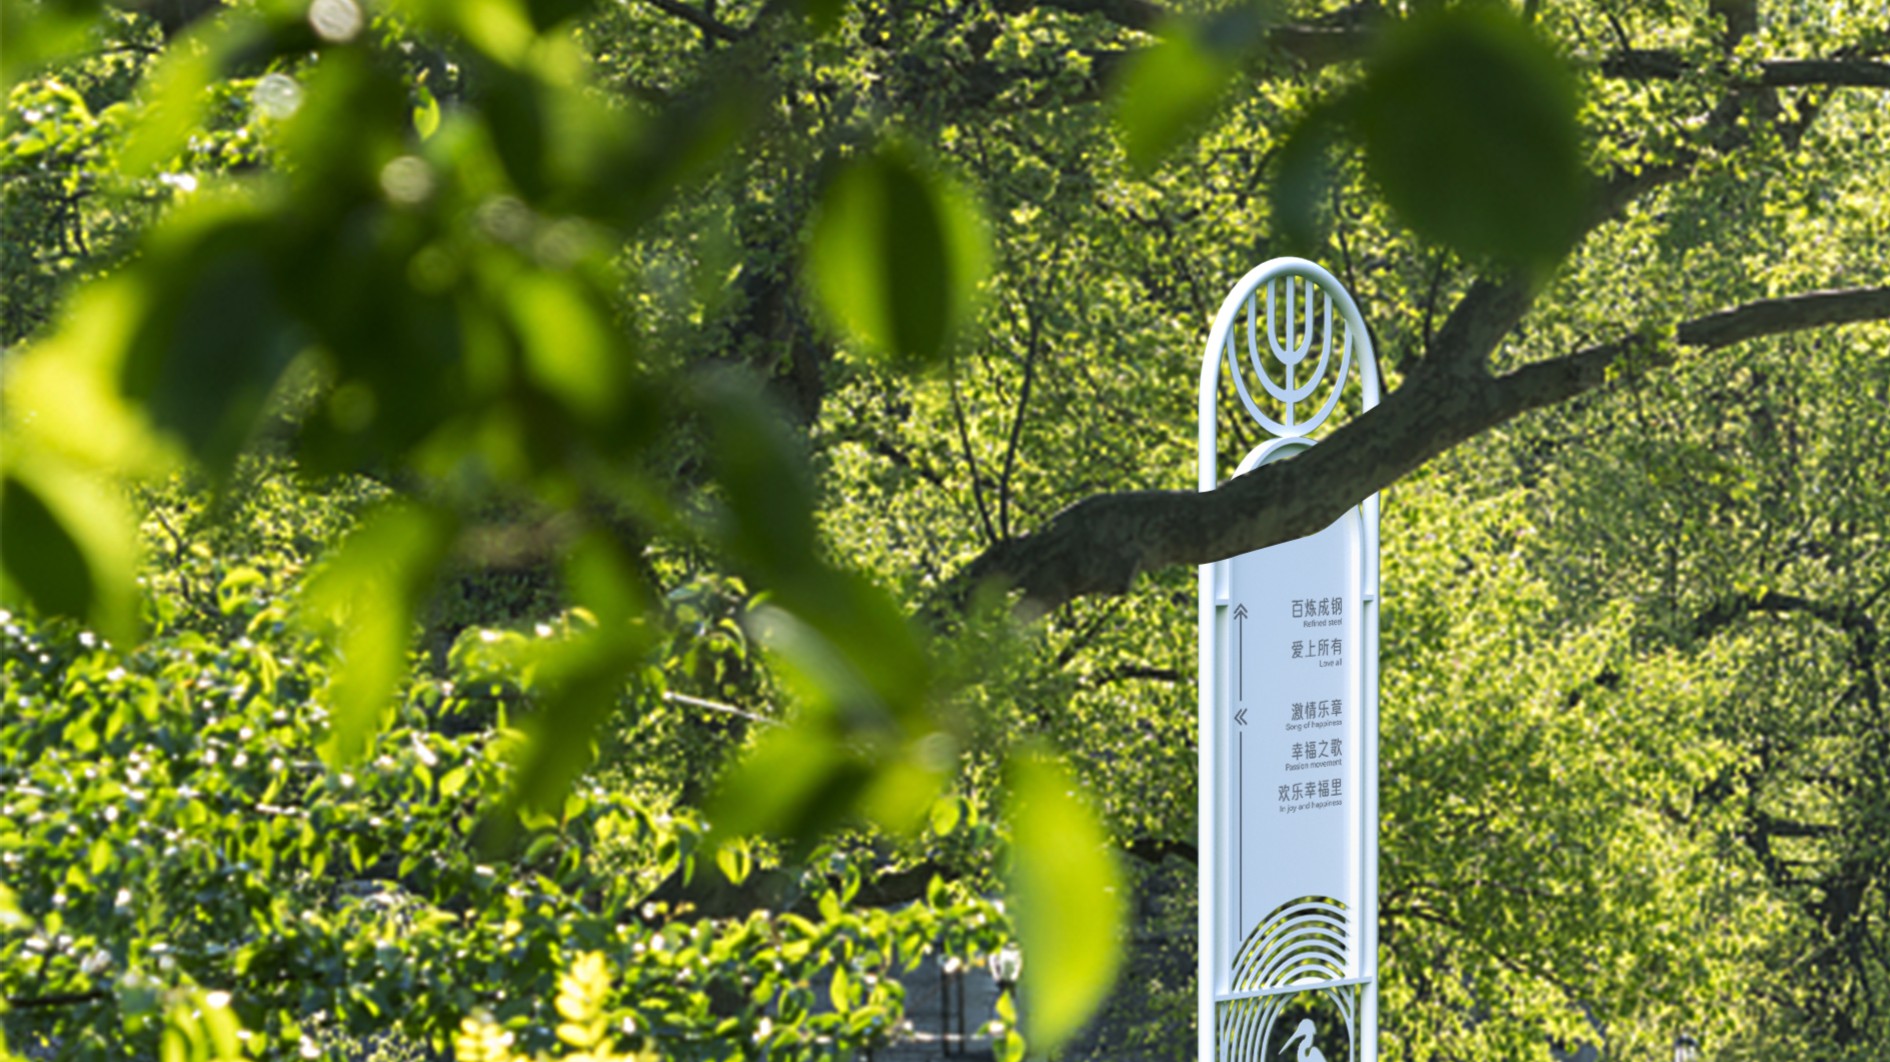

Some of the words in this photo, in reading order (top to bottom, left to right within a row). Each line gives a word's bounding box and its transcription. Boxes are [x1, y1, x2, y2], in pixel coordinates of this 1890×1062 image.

[1291, 596, 1343, 618] 百炼成钢
[1291, 637, 1342, 659] 爱上所有
[1291, 699, 1343, 721] 激情乐章
[1291, 738, 1343, 761] 幸福之歌
[1278, 778, 1343, 803] 欢乐幸福里
